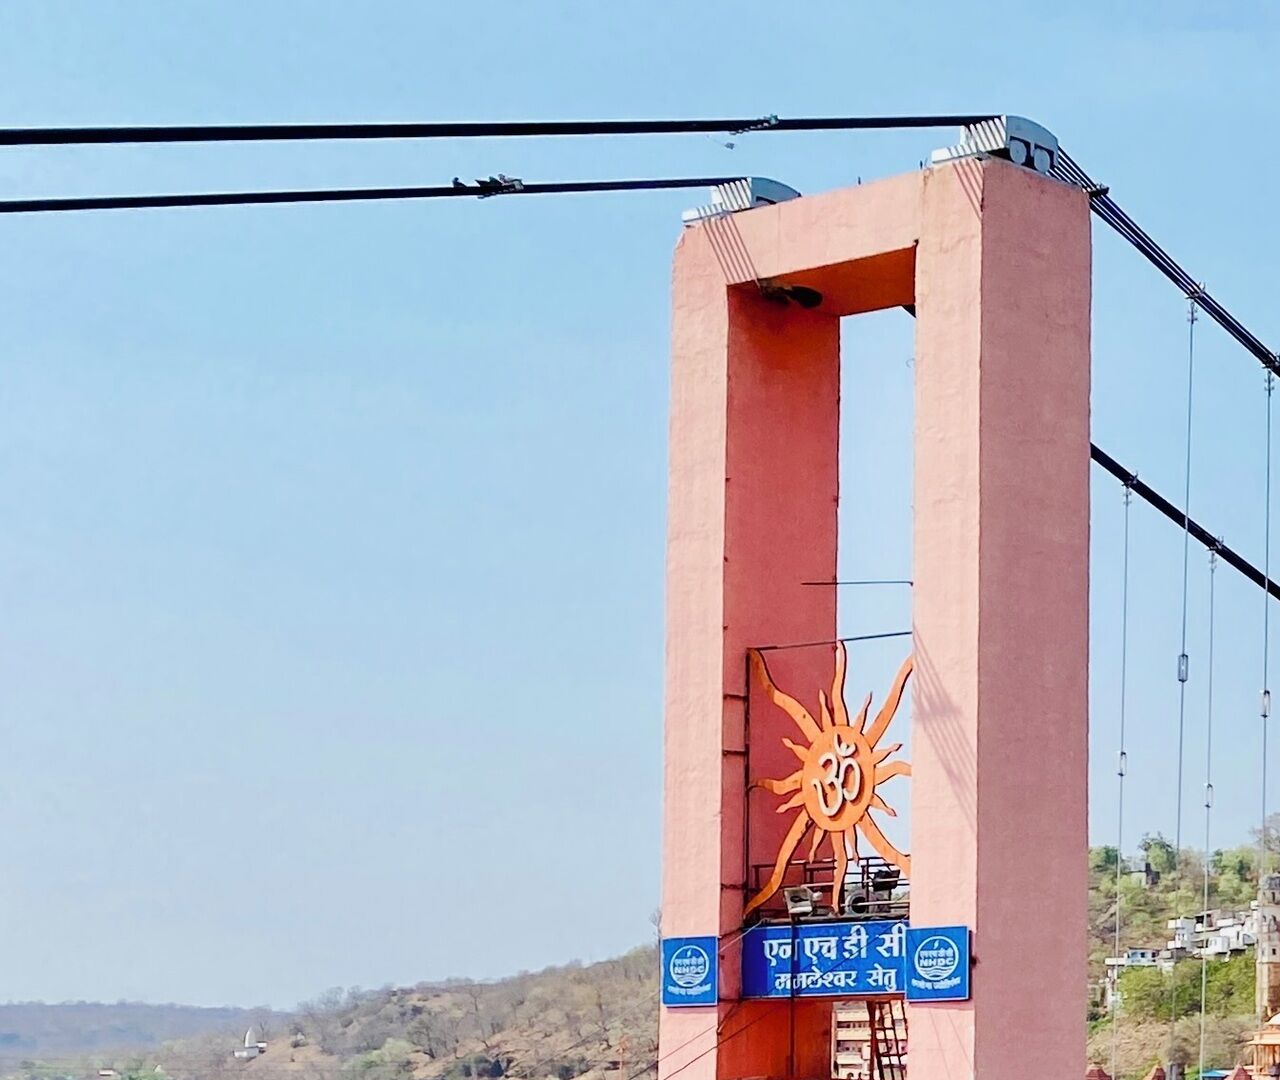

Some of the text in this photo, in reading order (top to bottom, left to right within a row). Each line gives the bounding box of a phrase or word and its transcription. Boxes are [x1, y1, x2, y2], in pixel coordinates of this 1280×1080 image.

[763, 922, 907, 966] एन एच डी सी
[674, 966, 705, 974] NHDC
[919, 958, 954, 967] NHDC
[774, 965, 858, 990] ममलेश्वर
[866, 963, 897, 991] सेतु
